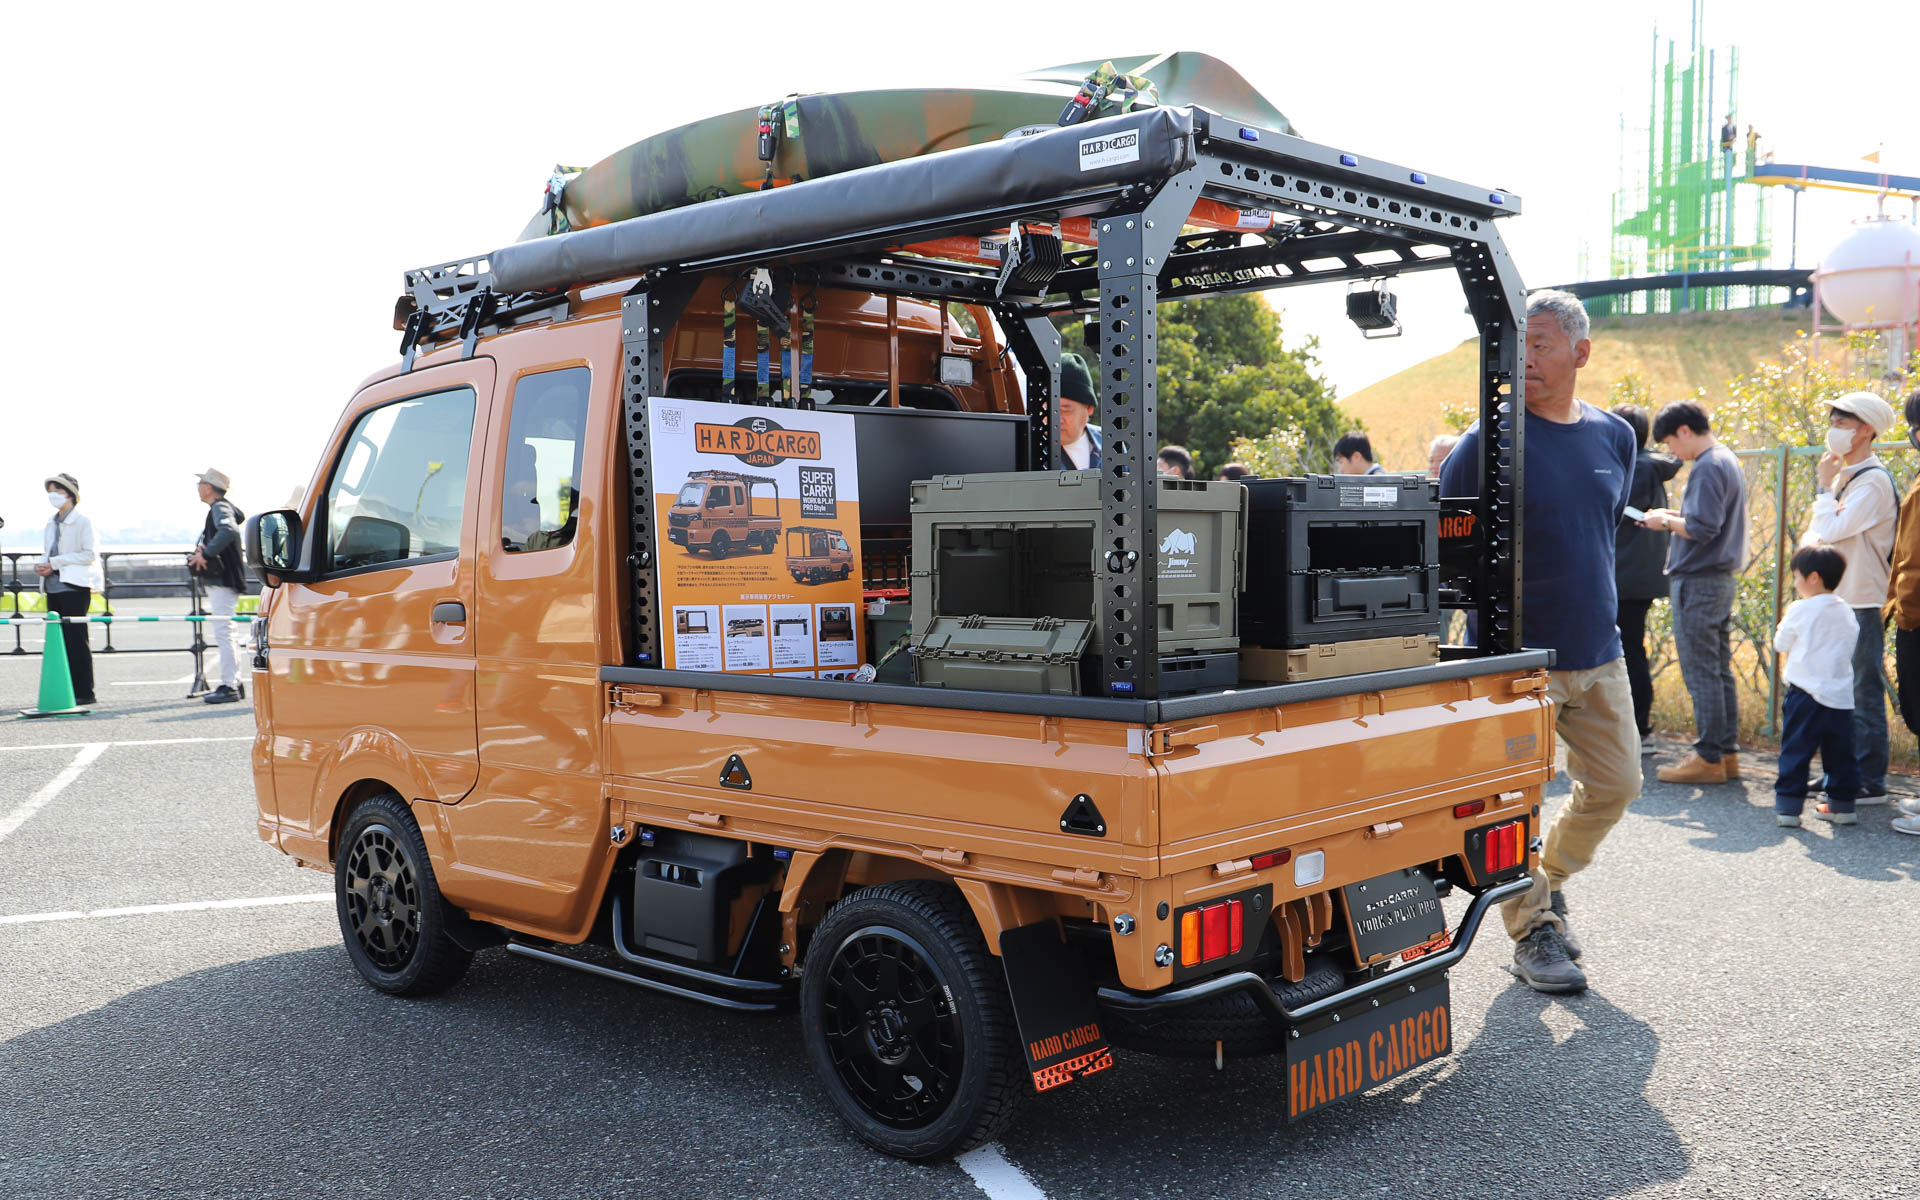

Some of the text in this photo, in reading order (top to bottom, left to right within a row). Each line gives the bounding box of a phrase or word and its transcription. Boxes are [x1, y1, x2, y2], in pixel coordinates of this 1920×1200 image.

[1083, 135, 1136, 155] HARD CARGO
[700, 428, 817, 455] HARD CARGO
[746, 454, 775, 465] JAPAN
[801, 470, 834, 485] SUPER
[802, 484, 834, 498] CARRY
[802, 503, 814, 511] PRO
[1437, 516, 1473, 538] ARGO
[1394, 904, 1416, 923] PLAY
[1418, 899, 1436, 916] PRO
[1030, 1023, 1100, 1062] HARD CARGO
[1290, 1005, 1448, 1118] HARD CARGO
